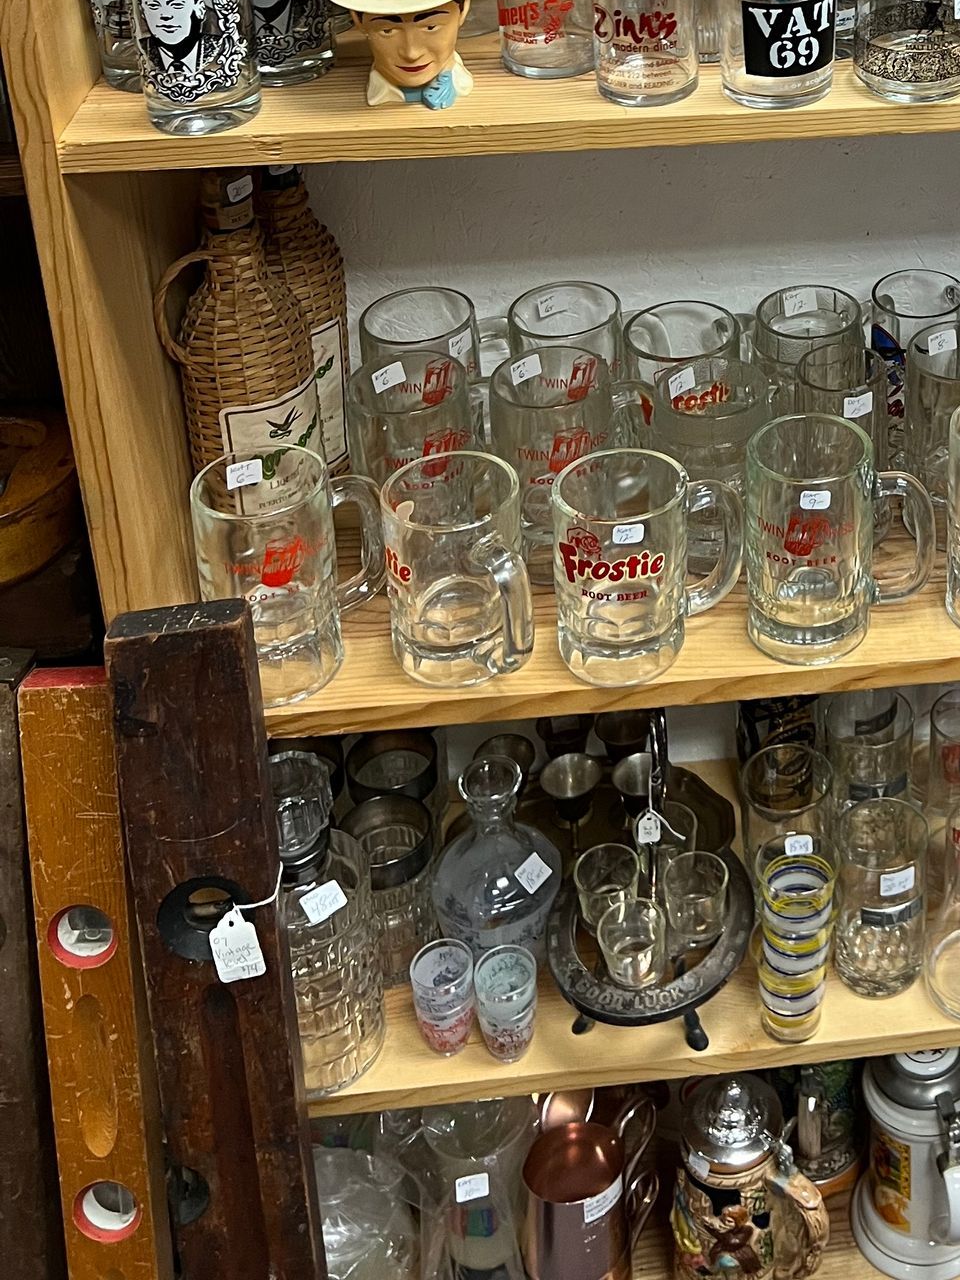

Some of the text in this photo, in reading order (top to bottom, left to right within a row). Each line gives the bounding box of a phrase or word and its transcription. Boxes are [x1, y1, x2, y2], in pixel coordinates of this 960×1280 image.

[612, 40, 678, 53] modern diner
[769, 36, 820, 69] 69
[529, 477, 555, 486] ROO
[559, 541, 666, 584] Frostie
[765, 551, 837, 568] ROOT BEER
[581, 588, 648, 602] ROOT BEER
[214, 943, 256, 959] Vintage
